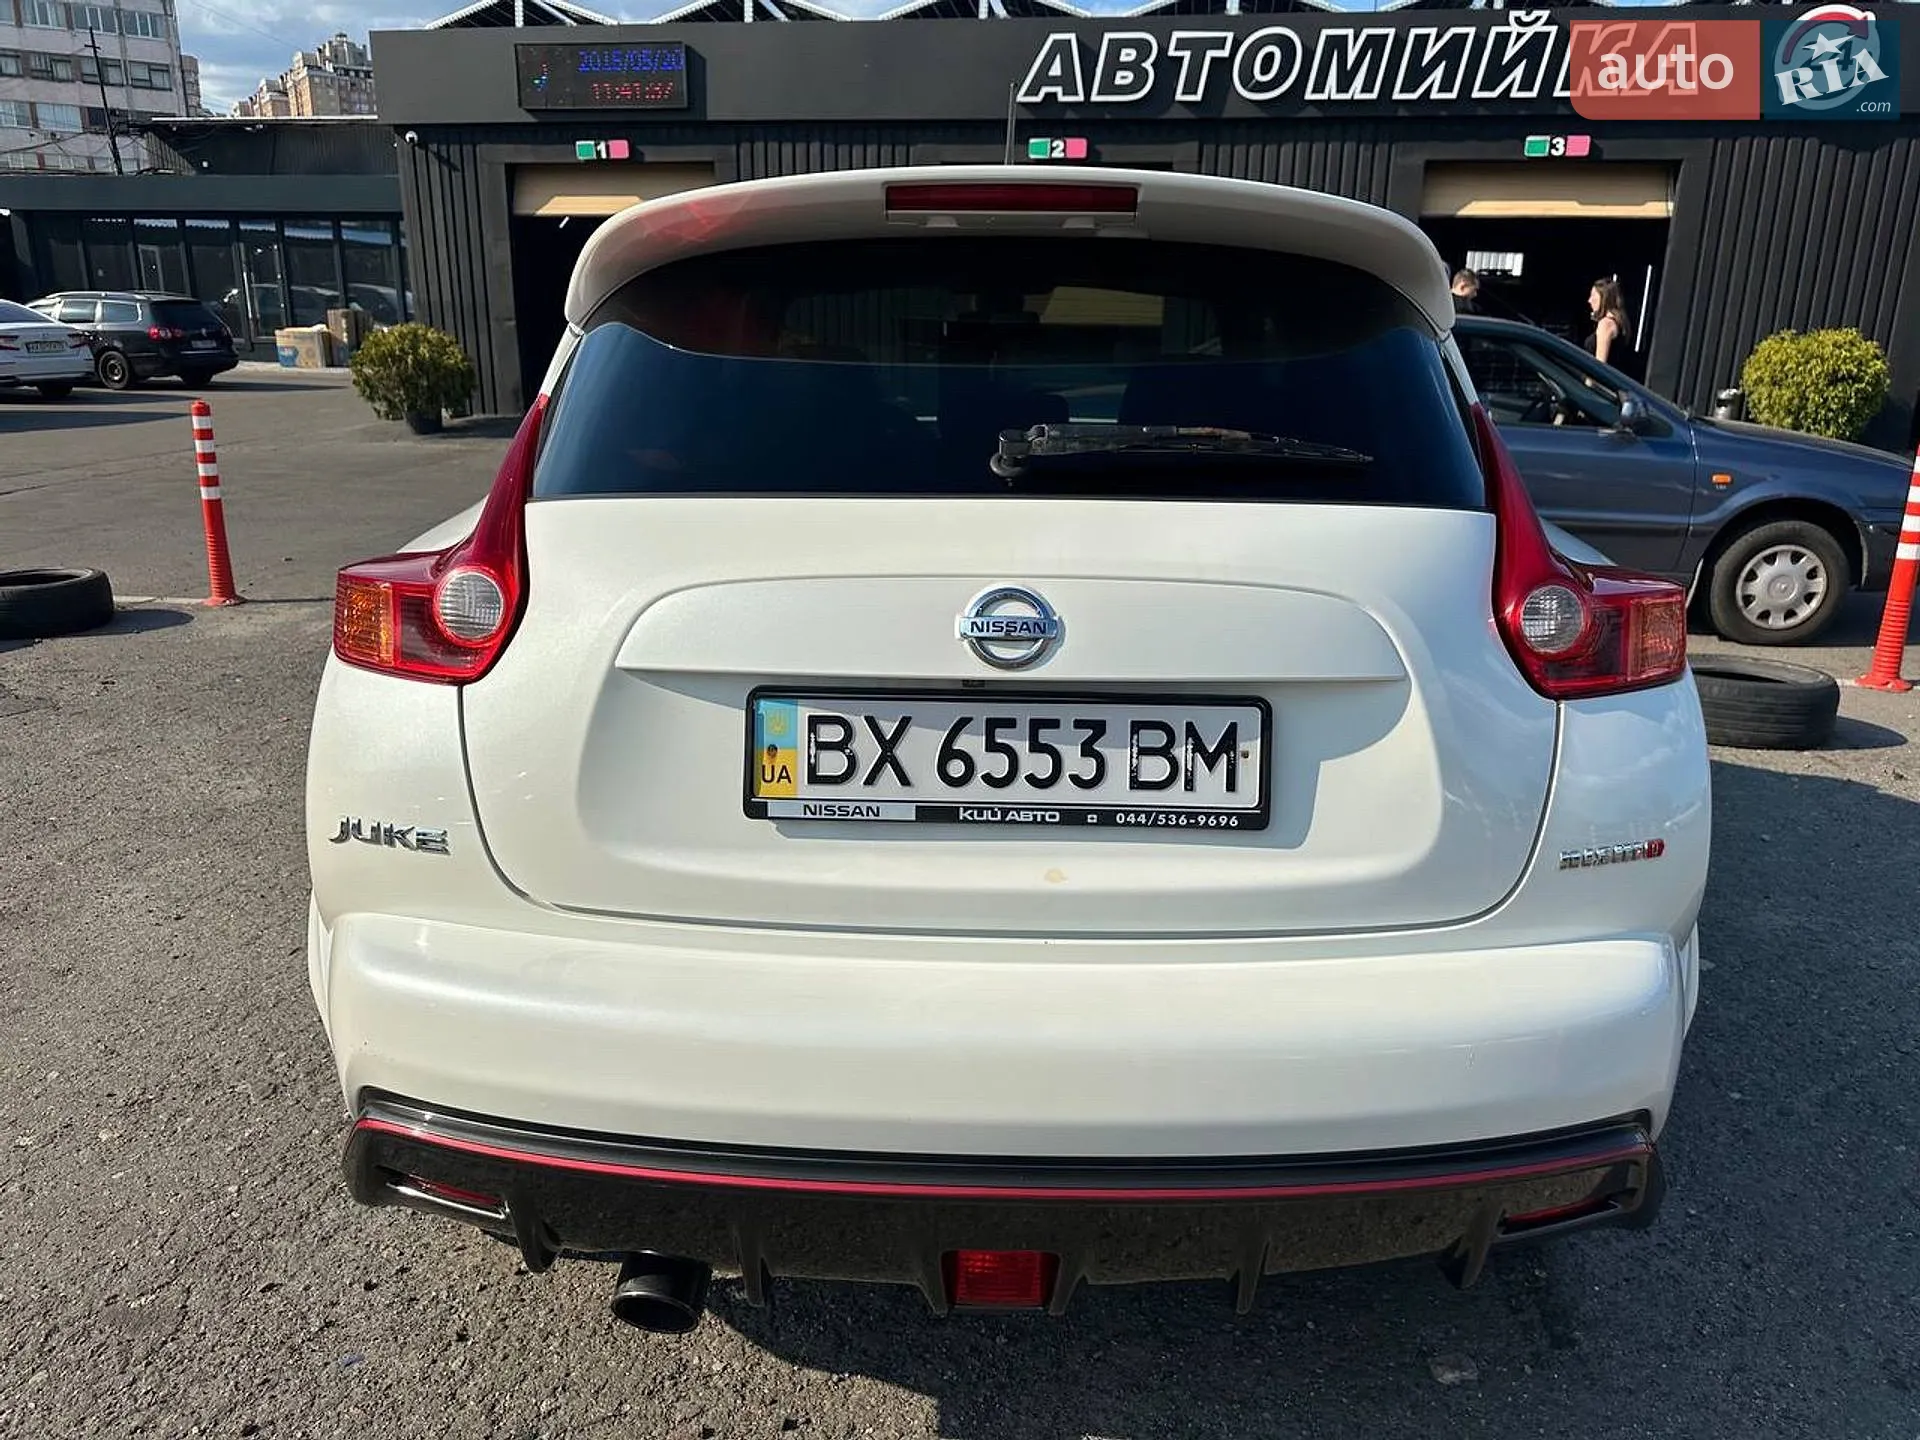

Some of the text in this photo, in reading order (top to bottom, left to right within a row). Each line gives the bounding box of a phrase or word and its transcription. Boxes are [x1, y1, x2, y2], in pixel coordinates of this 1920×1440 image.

[1016, 9, 1698, 101] АВТОМИЙКА
[597, 141, 607, 159] 1
[1051, 140, 1065, 158] 2
[1551, 137, 1565, 157] 3
[970, 620, 1048, 635] NISSAN
[806, 714, 1239, 793] BX 6553 BM
[761, 765, 792, 785] UA
[802, 804, 881, 818] NISSAN
[1115, 812, 1239, 827] 044/536-9696
[328, 816, 451, 856] JUKE
